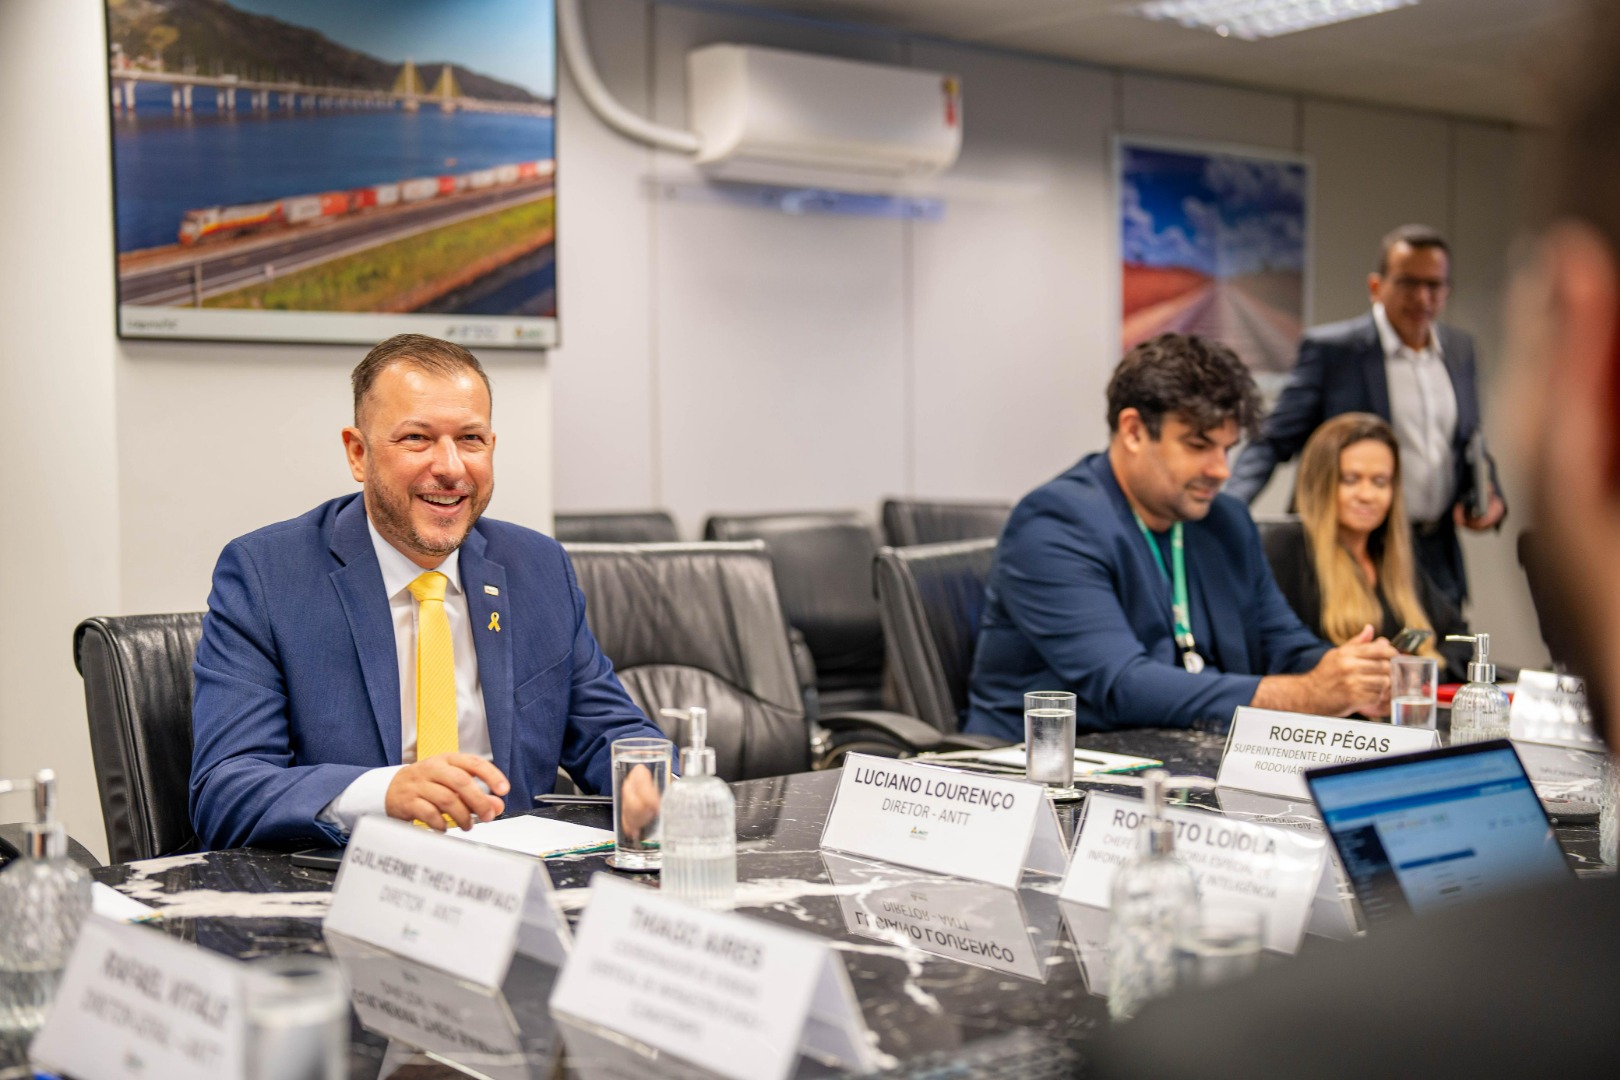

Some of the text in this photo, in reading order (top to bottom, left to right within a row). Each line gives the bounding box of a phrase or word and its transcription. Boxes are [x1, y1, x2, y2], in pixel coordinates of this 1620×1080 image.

[1233, 743, 1317, 762] SUPERINTENDENTE
[1319, 753, 1332, 763] DE
[1269, 726, 1391, 753] ROGER PÊGAS
[855, 767, 1015, 811] LUCIANO LOURENÇO
[881, 798, 930, 818] DIRETOR
[937, 810, 971, 826] ANTT
[1113, 808, 1277, 856] ROTO LOIOLA
